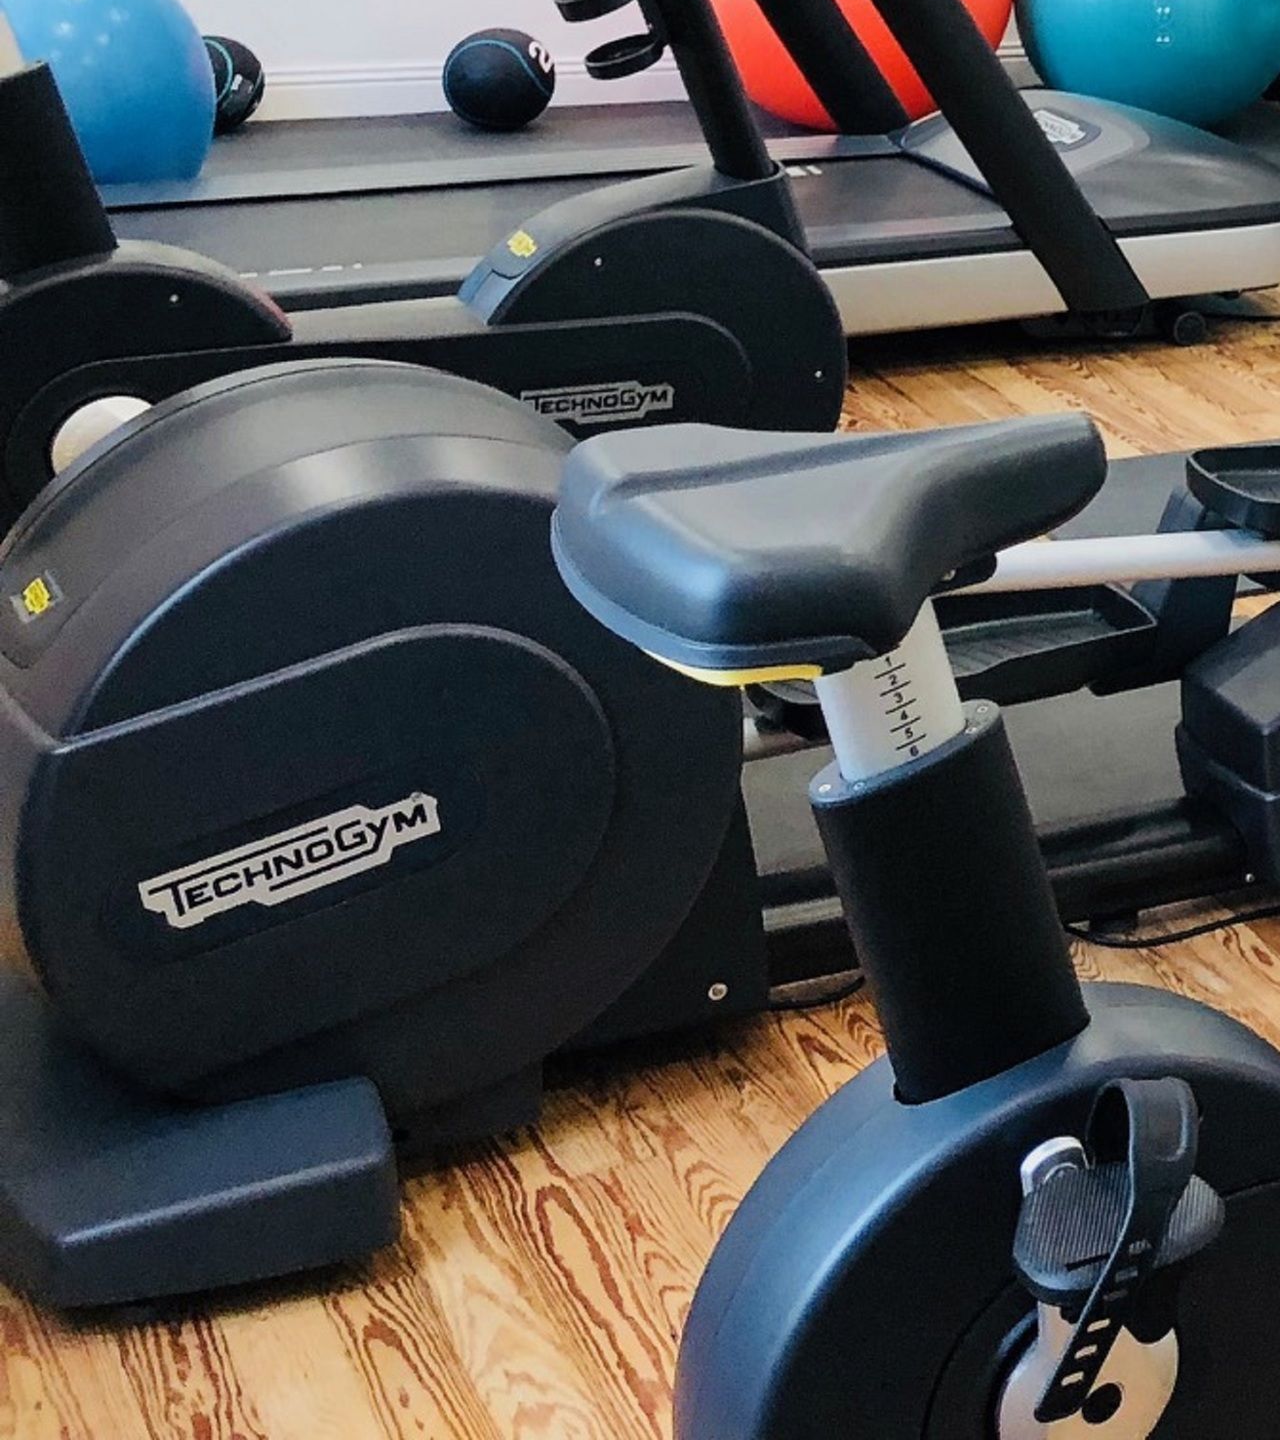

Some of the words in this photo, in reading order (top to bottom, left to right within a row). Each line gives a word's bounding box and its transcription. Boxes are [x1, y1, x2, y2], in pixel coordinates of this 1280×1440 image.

[888, 674, 897, 685] 2
[893, 692, 903, 703] 3
[901, 710, 908, 720] 4
[905, 727, 913, 739] 5
[910, 745, 919, 757] 6
